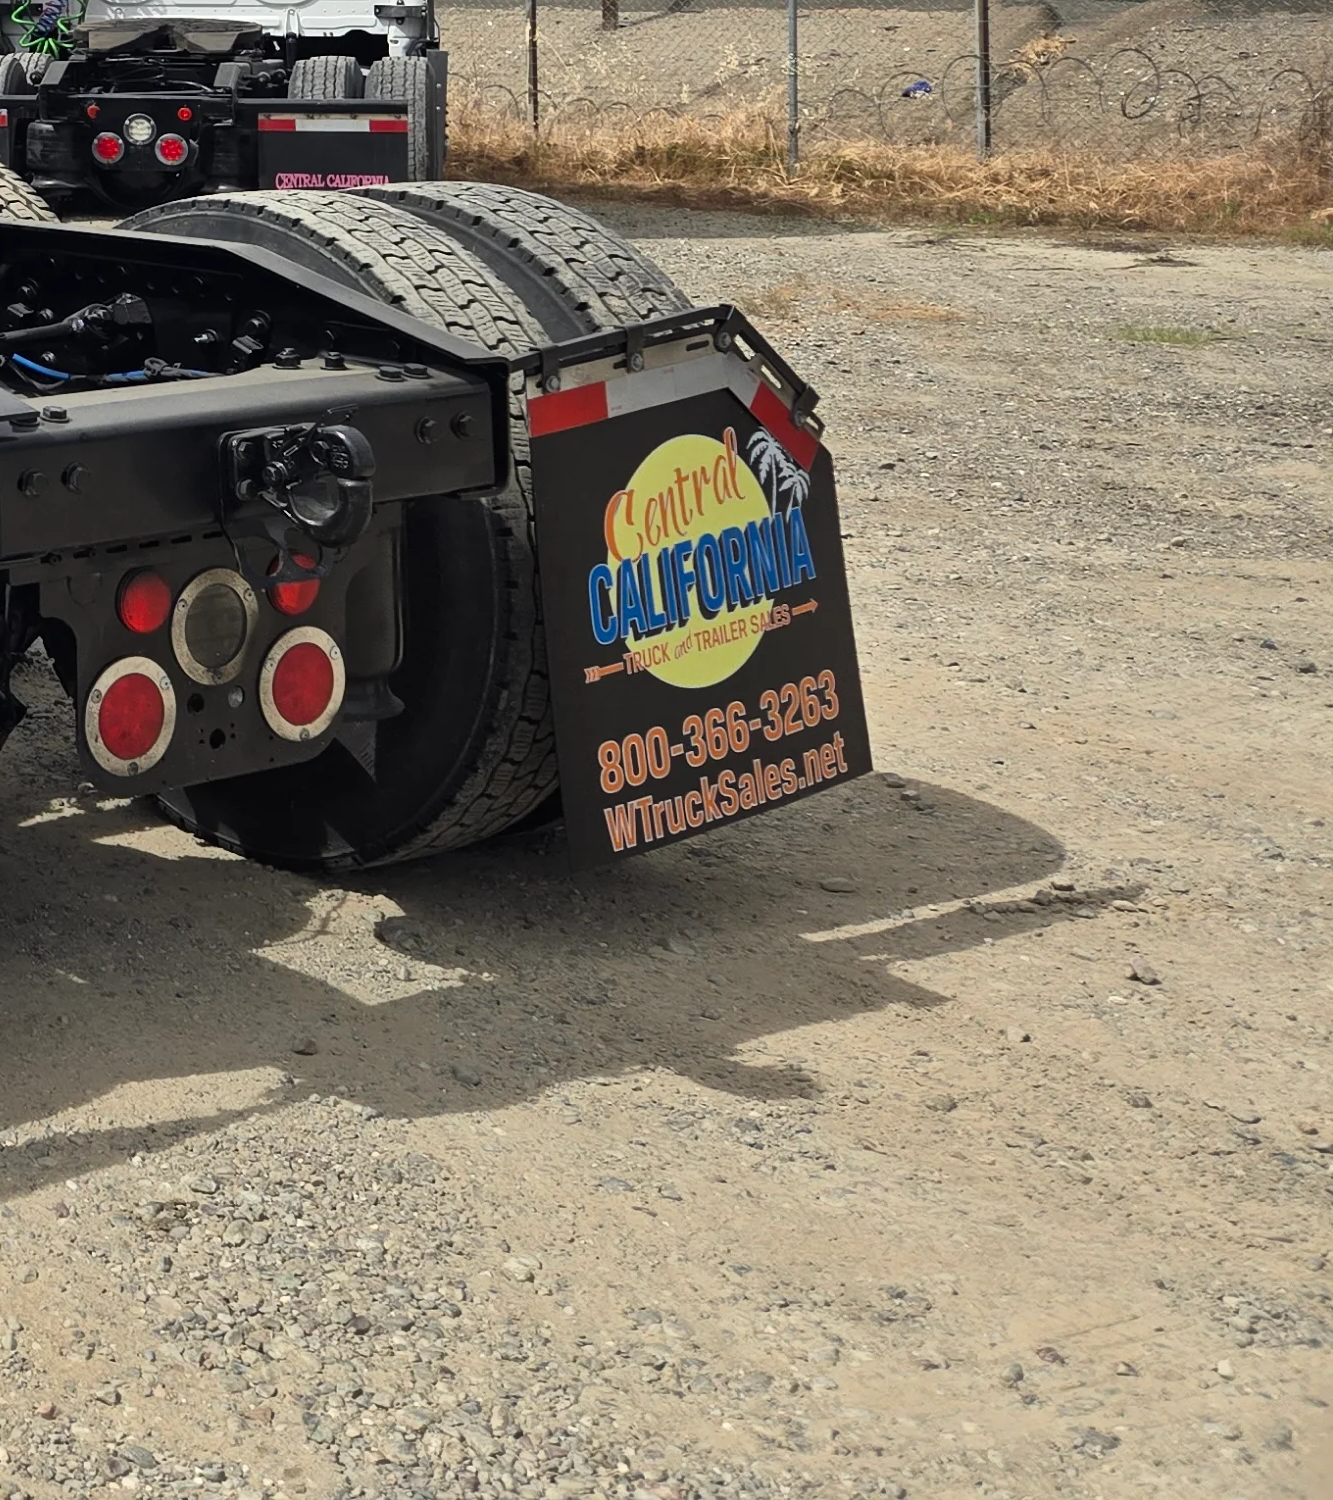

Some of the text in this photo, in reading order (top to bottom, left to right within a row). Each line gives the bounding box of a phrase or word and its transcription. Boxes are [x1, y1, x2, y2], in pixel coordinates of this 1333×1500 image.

[275, 172, 325, 190] CENTRAL
[603, 426, 746, 563] Central
[587, 505, 816, 646] CALIFORNIA
[622, 603, 791, 675] TRUCK and TRAILER SALES
[597, 668, 840, 794] 800-366-3263
[603, 731, 848, 852] WTruckSales.net
